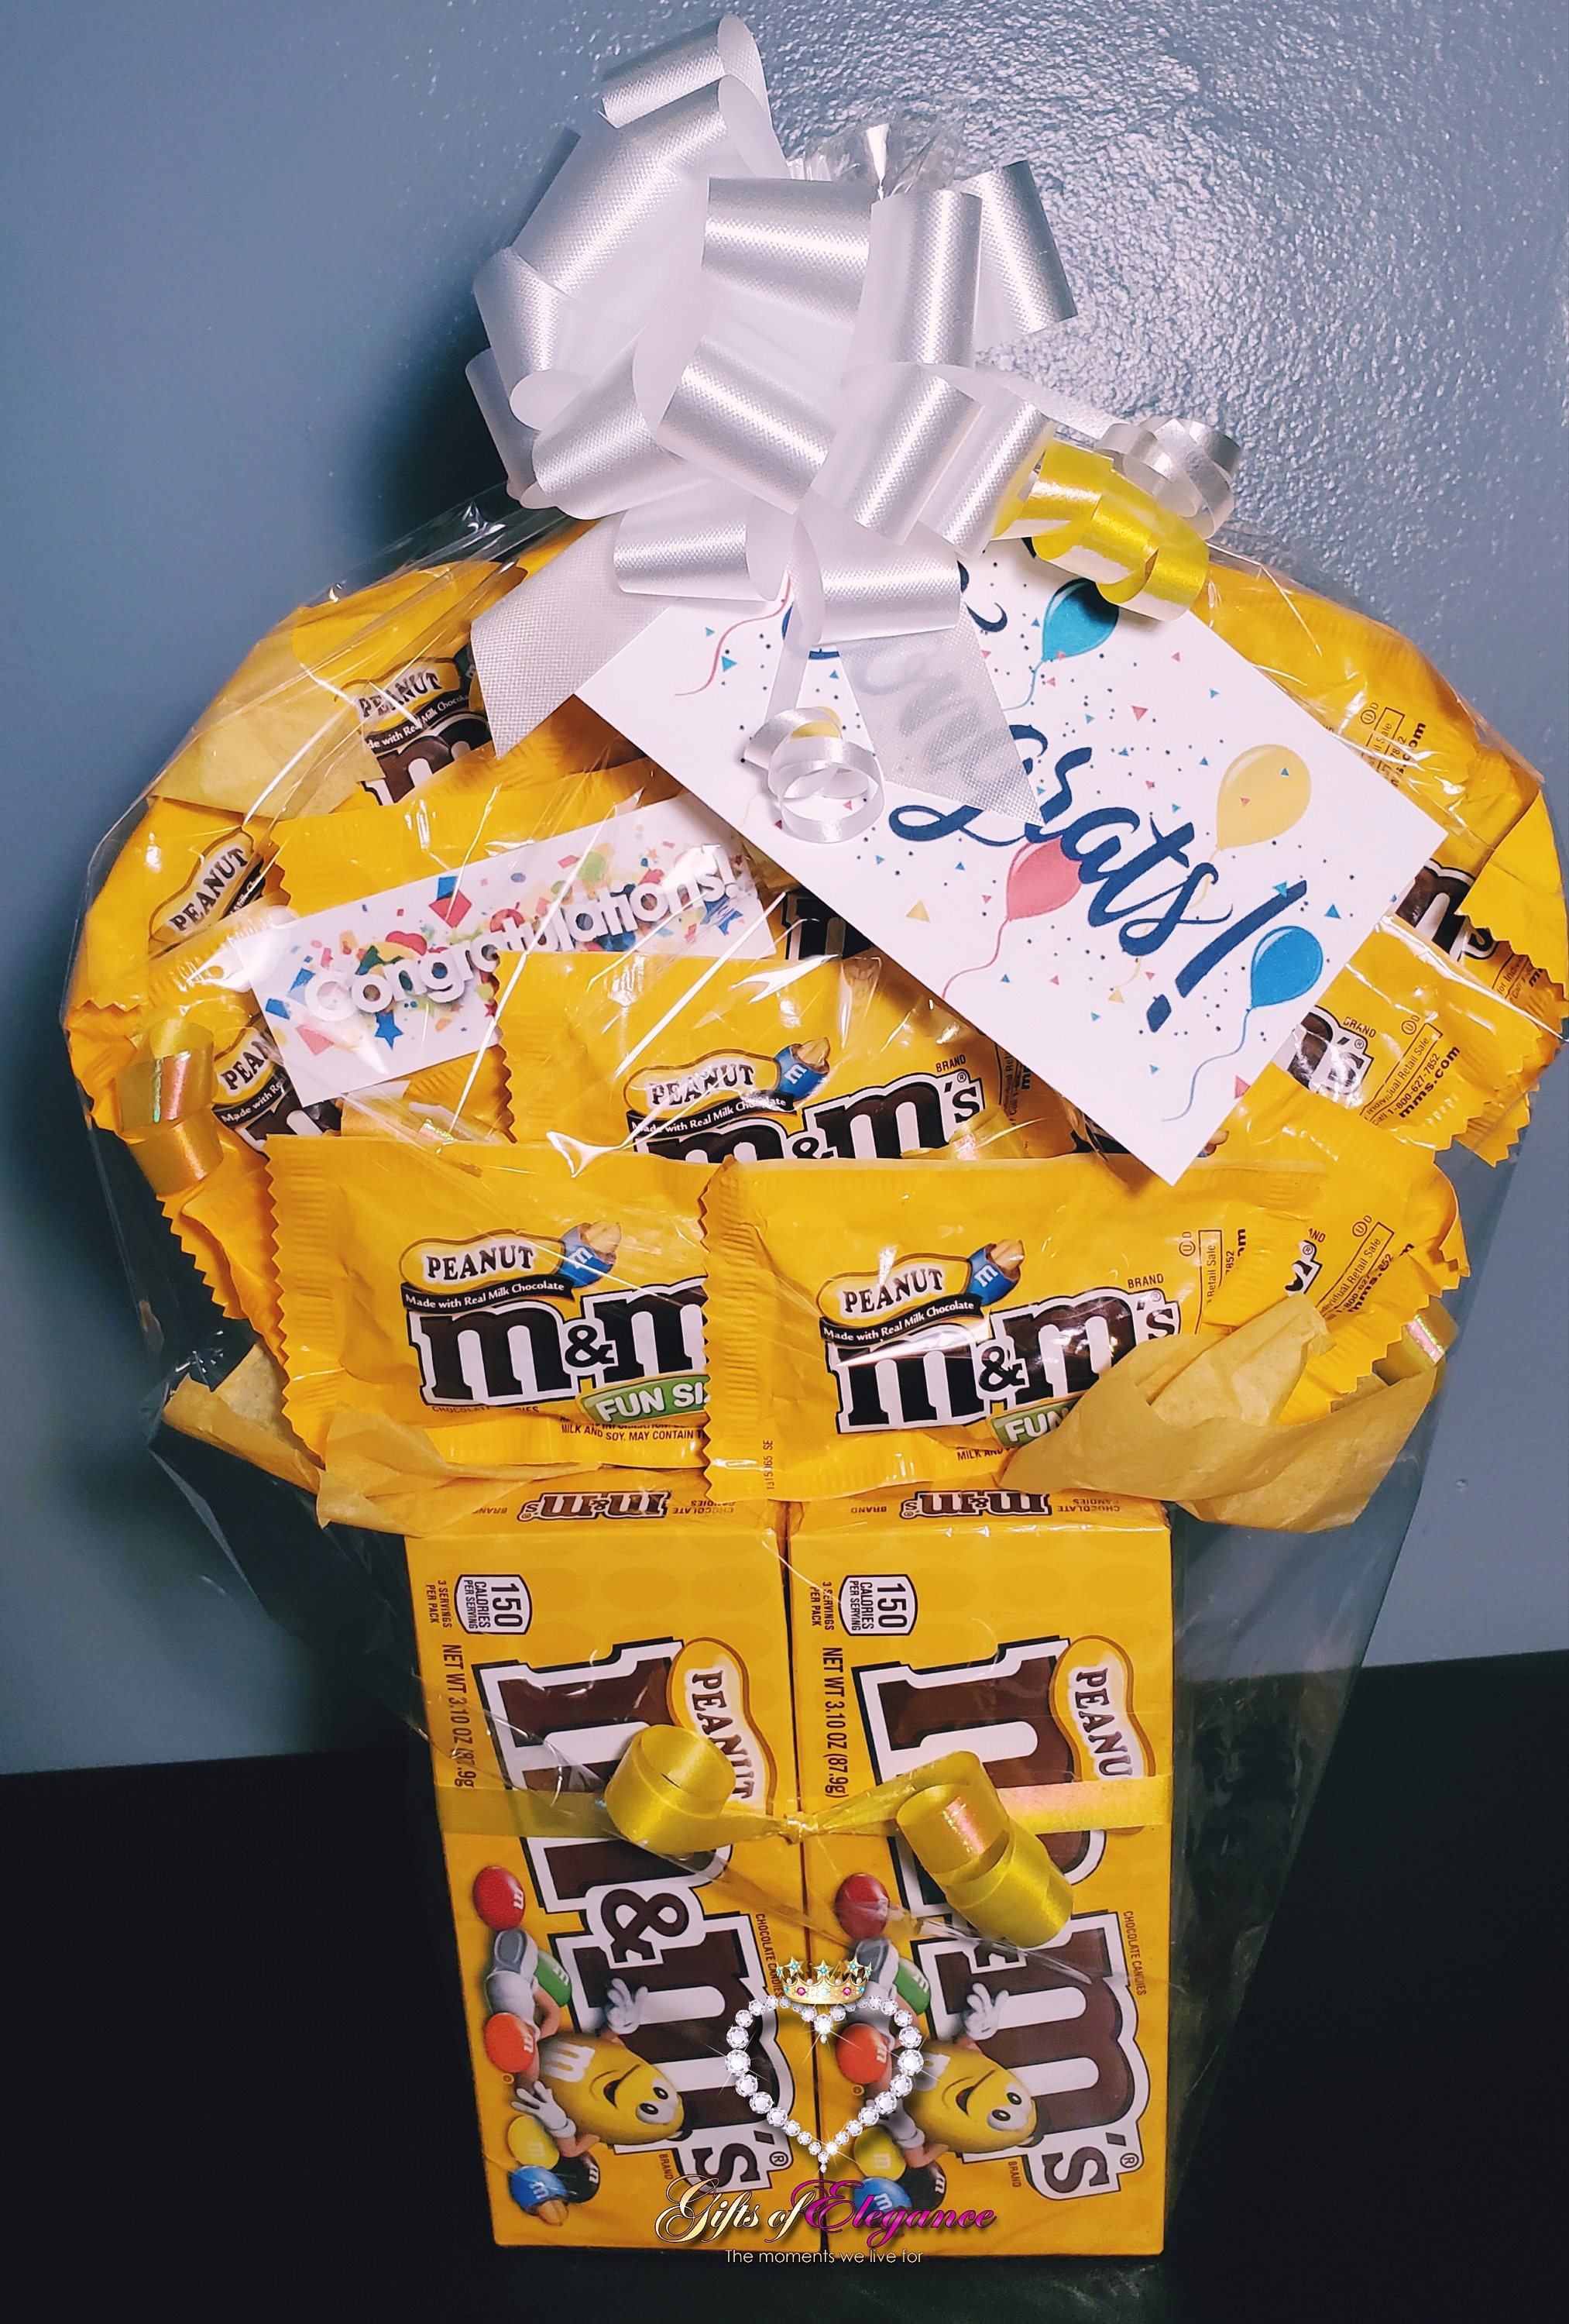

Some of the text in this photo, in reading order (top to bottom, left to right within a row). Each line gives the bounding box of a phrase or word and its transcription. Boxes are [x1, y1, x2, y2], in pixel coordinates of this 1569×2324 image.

[170, 847, 249, 931] PEANUT
[936, 1054, 966, 1073] BRAND
[1398, 1054, 1418, 1081] Retail
[1398, 1045, 1461, 1119] mms.com
[651, 1063, 754, 1106] PEANUT
[1387, 1052, 1440, 1116] 1-800-627-7852
[220, 1105, 252, 1124] Made
[252, 1092, 273, 1110] with
[664, 1121, 688, 1133] with
[689, 1115, 712, 1129] Real
[712, 1105, 734, 1122] Milk
[426, 1243, 534, 1281] PEANUT
[1127, 1273, 1165, 1290] BRAND
[1347, 1257, 1369, 1284] Retail
[405, 1280, 565, 1309] Made with Real Milk Chocolate
[843, 1268, 945, 1314] PEANUT
[823, 1300, 975, 1342] Made with Real Milk Chocolate
[836, 1295, 1176, 1427] m&m's
[596, 1383, 711, 1422] FUN SI
[561, 1423, 582, 1434] MILK
[584, 1425, 603, 1438] AND
[629, 1431, 650, 1442] MAY
[652, 1429, 694, 1441] CONTAIN
[956, 1449, 982, 1461] MILK
[473, 1507, 508, 1516] BRAN
[851, 1505, 887, 1514] BRAND
[905, 1492, 1050, 1517] m&m's
[426, 1584, 440, 1624] PER PACK
[438, 1587, 452, 1628] SERVINGS
[464, 1580, 479, 1630] PER SERVING
[474, 1581, 491, 1628] CALORIES
[491, 1583, 524, 1628] 150
[809, 1586, 822, 1626] PER PACK
[822, 1589, 835, 1631] SERVINGS
[849, 1580, 861, 1631] PER SERVING
[860, 1582, 874, 1630] CALORIES
[877, 1583, 908, 1628] 150
[441, 1644, 465, 1670] NET
[445, 1673, 467, 1694] WT
[448, 1696, 471, 1724] 3.10
[822, 1647, 850, 1799] NET WT 3.10 OZ (87.9g)
[452, 1728, 474, 1745] OZ
[496, 1656, 776, 2185] m&m's
[755, 1913, 776, 1961] CHOCOLATE
[876, 1656, 1132, 2197] mm's
[1123, 1910, 1148, 1996] CHOCOLATE CANDIES
[658, 2153, 675, 2181] BRAND
[1008, 2160, 1022, 2188] BRAND
